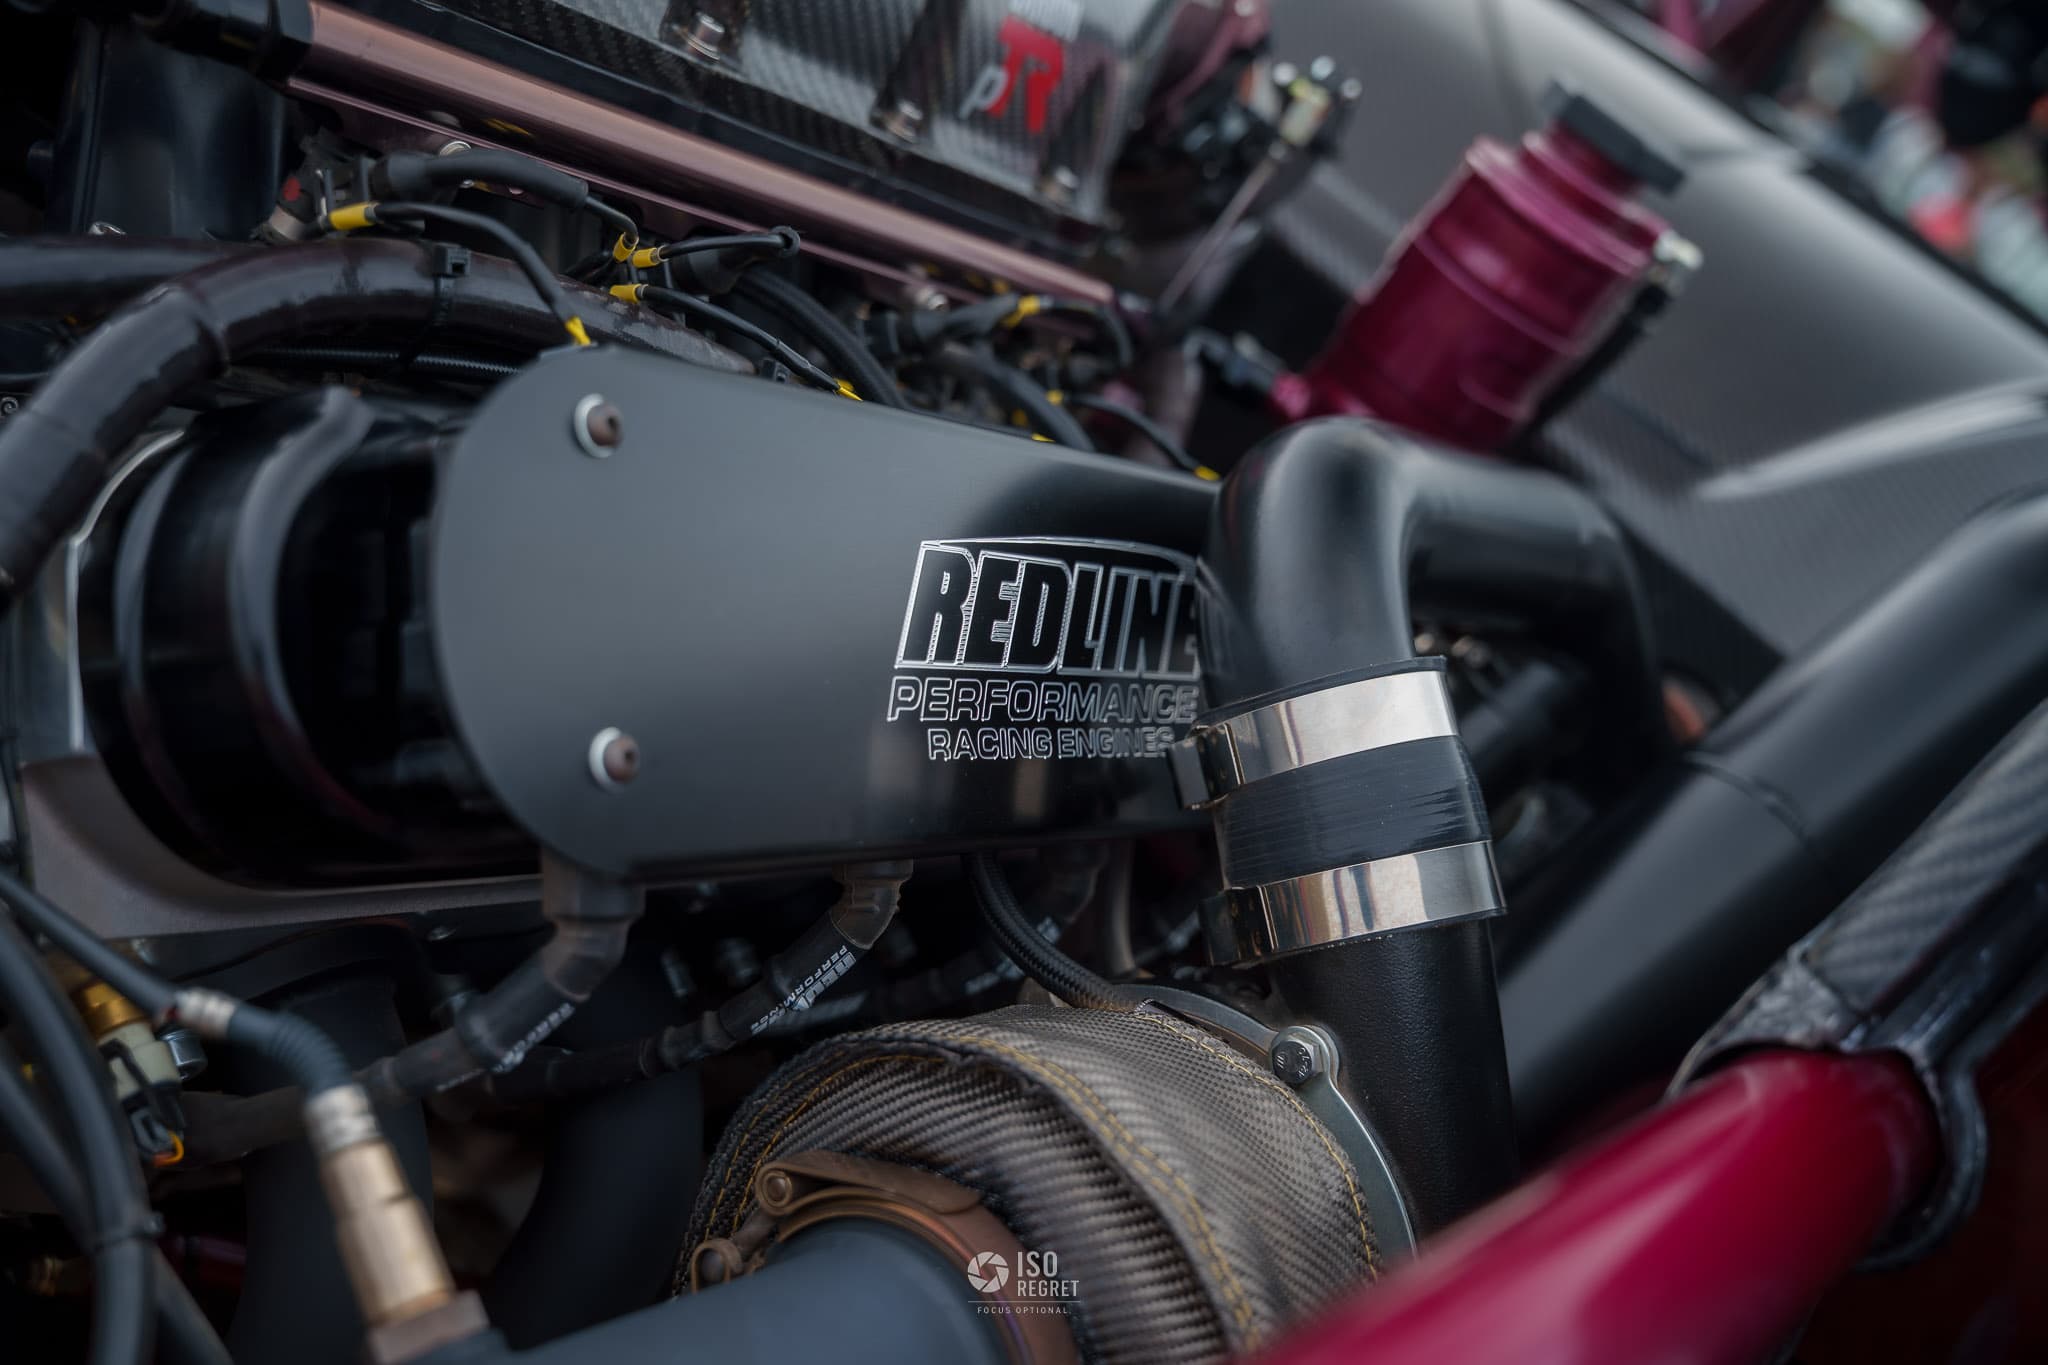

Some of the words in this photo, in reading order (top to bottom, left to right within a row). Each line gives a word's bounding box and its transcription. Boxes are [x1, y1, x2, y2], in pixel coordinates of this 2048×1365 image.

[894, 536, 1200, 682] REDLINE
[886, 676, 1199, 723] PERFORMANCE
[927, 728, 1053, 761] RACING
[1057, 726, 1176, 759] ENGINES
